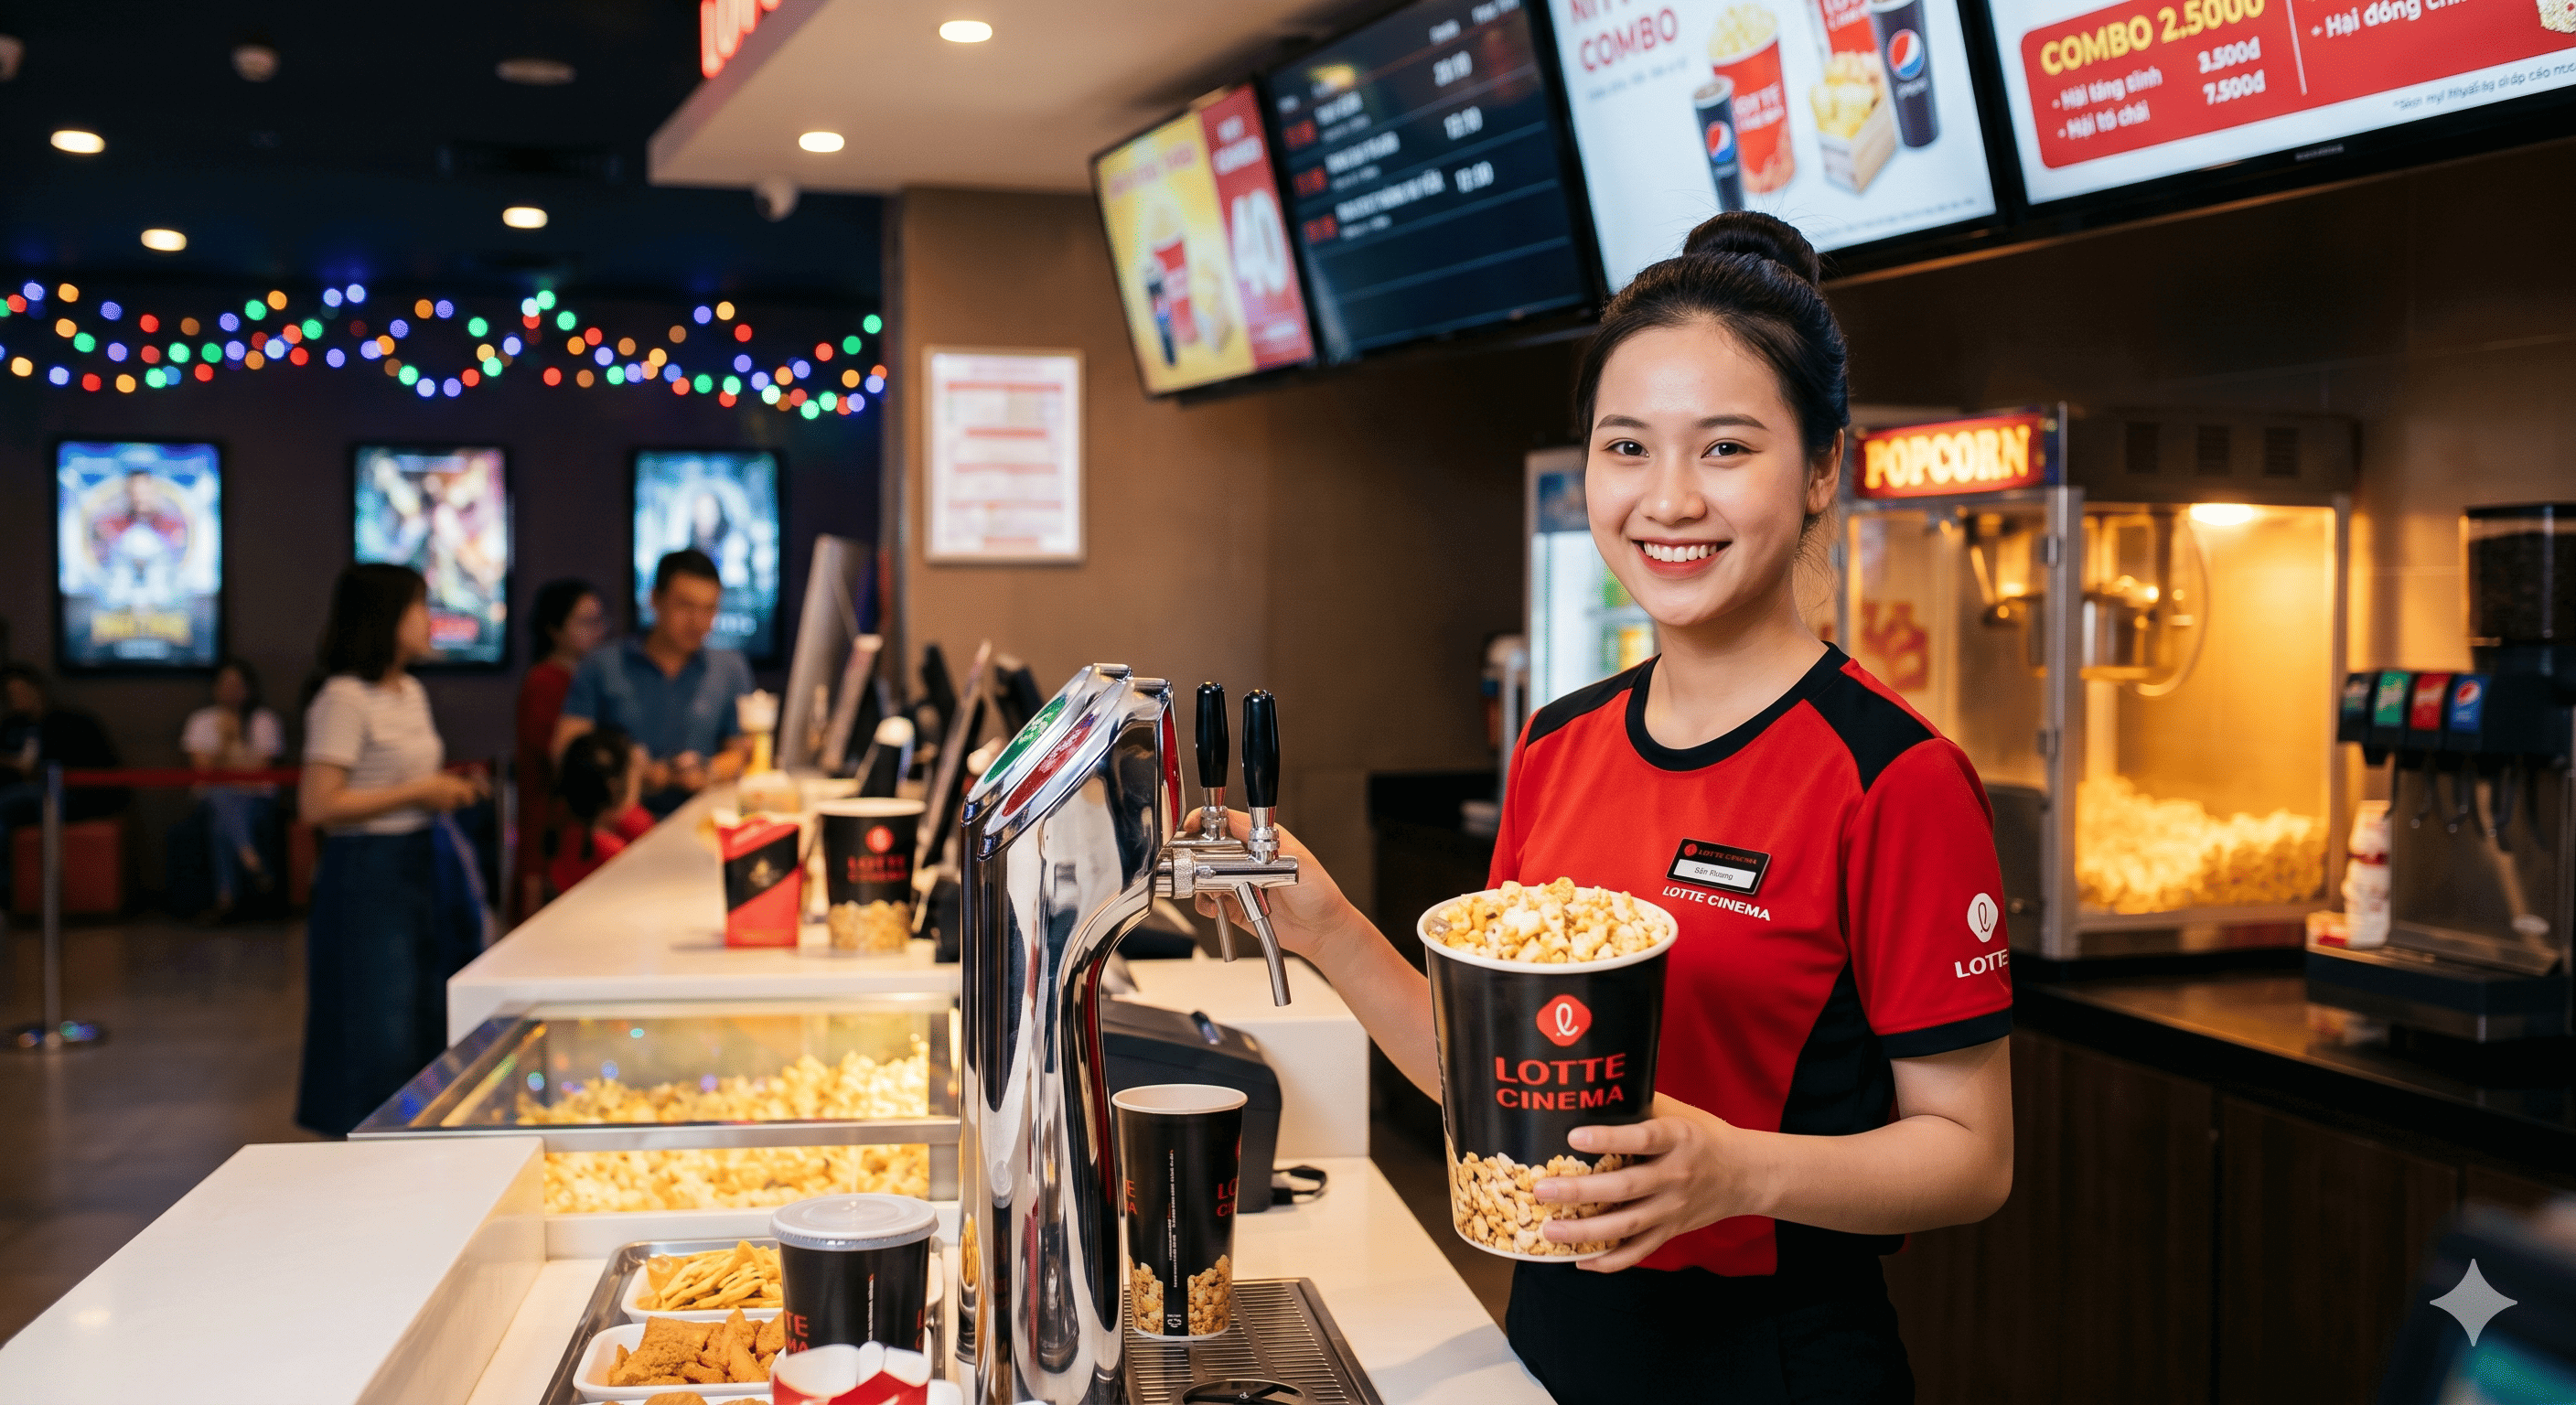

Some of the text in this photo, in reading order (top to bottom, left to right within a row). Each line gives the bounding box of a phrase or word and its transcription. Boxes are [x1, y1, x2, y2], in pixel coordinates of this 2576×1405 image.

[1579, 6, 1680, 73] COMBO
[2040, 15, 2154, 76] COMBO
[1864, 424, 2031, 489] POPCORN
[1662, 885, 1771, 922] LOTTE CINEMA
[1495, 1053, 1626, 1087] LOTTE
[1496, 1084, 1625, 1111] CINEMA
